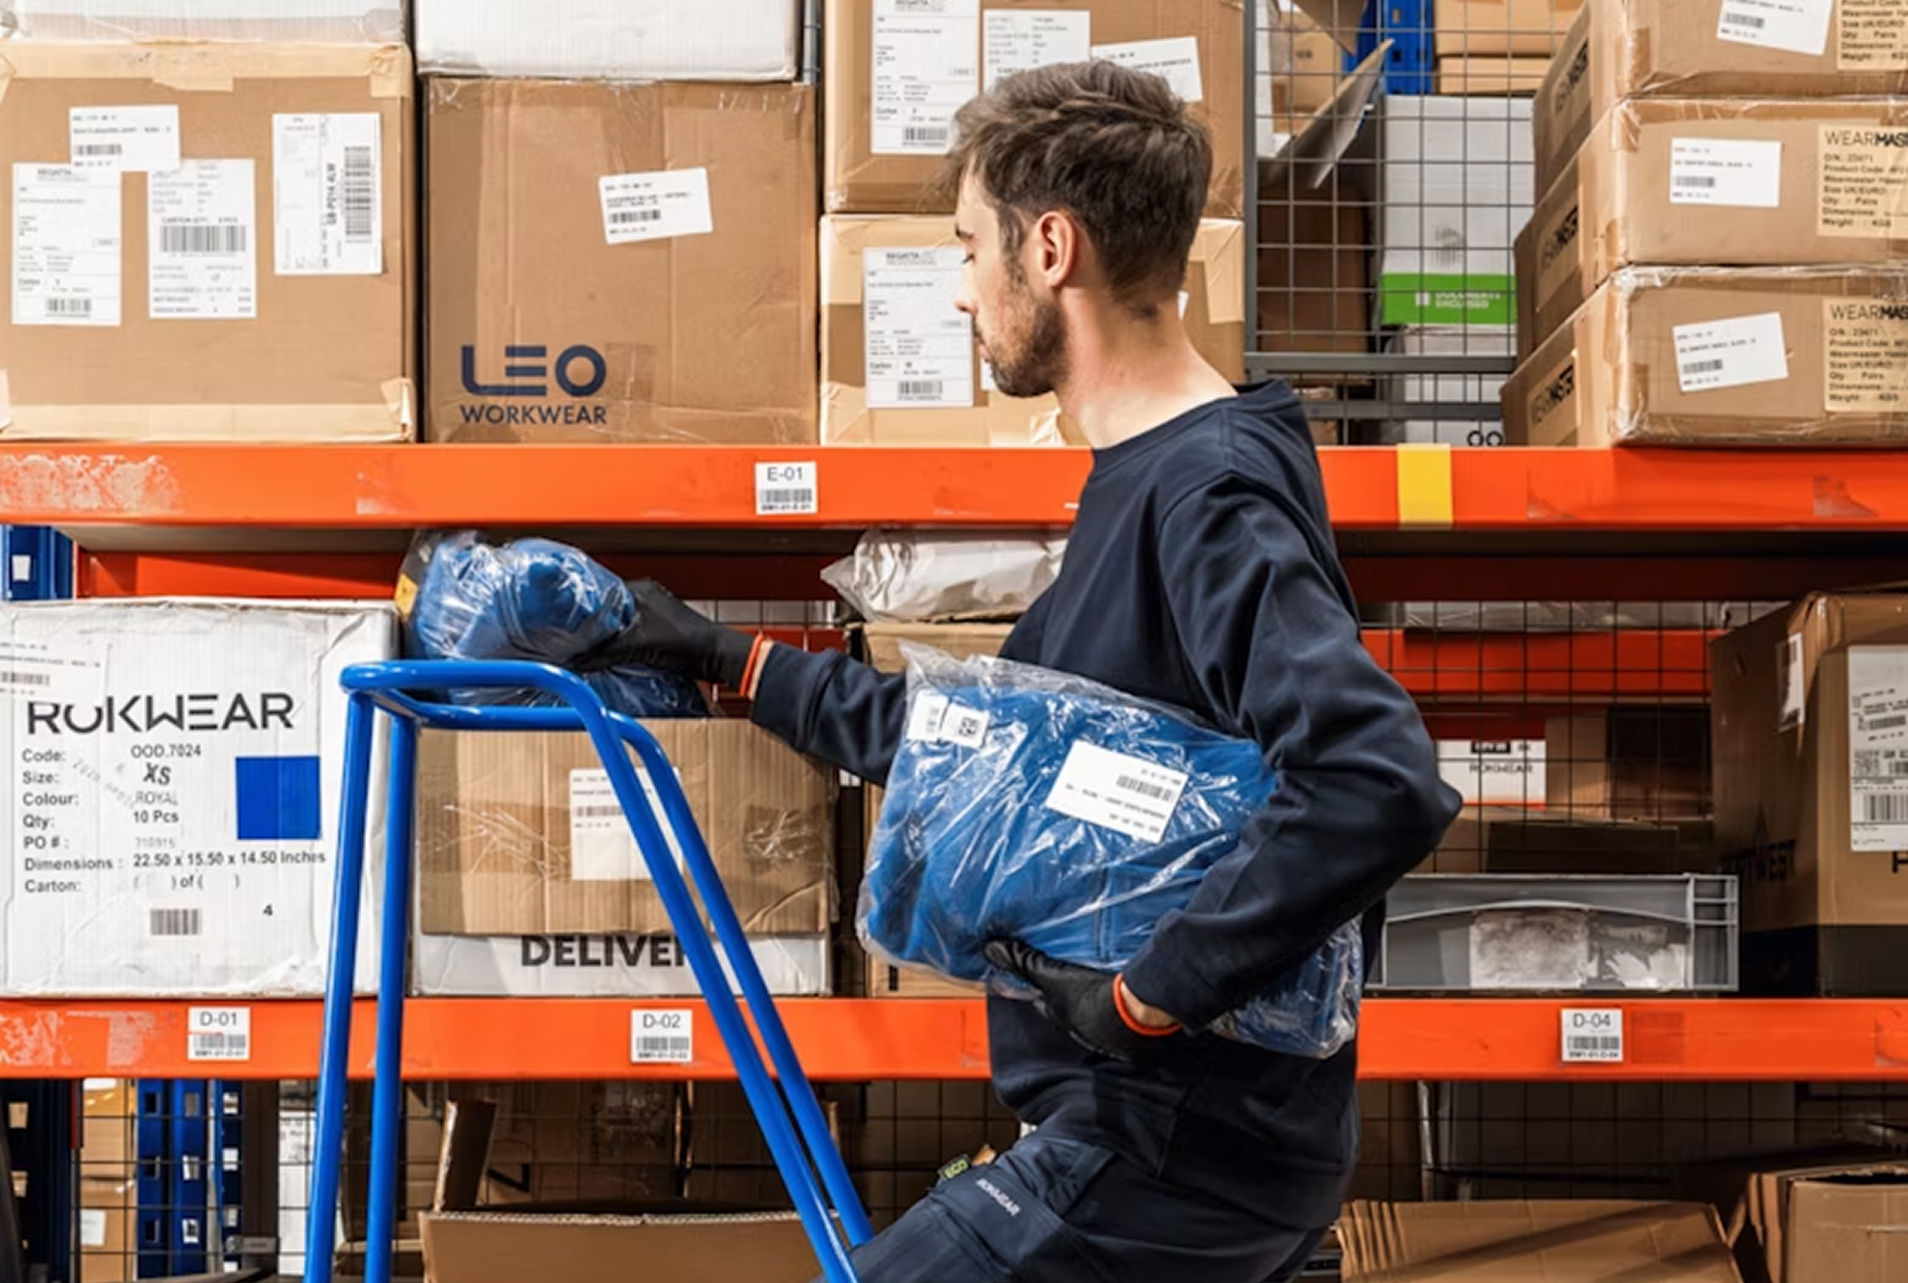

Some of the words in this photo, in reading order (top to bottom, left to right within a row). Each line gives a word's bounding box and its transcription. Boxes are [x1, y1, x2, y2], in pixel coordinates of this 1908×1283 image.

[461, 344, 607, 397] LEO
[459, 404, 607, 425] WORKWEAR
[767, 466, 802, 482] E-01
[22, 748, 66, 763] Code:
[22, 771, 60, 785] Size:
[143, 762, 172, 786] XS
[22, 792, 80, 807] Colour:
[22, 813, 55, 831] Qty:
[133, 811, 149, 824] 10
[153, 810, 179, 824] Pcs
[23, 836, 46, 850] PO
[24, 857, 114, 872] Dimensions
[133, 853, 171, 868] 22.50
[174, 855, 183, 866] x
[187, 852, 224, 866] 15.50
[227, 854, 236, 865] x
[240, 851, 277, 865] 14.50
[280, 850, 326, 865] Inches
[24, 878, 81, 893] Carton:
[180, 875, 195, 888] of
[200, 1011, 238, 1027] D-01
[642, 1013, 681, 1029] D-02
[1573, 1012, 1611, 1028] D-04
